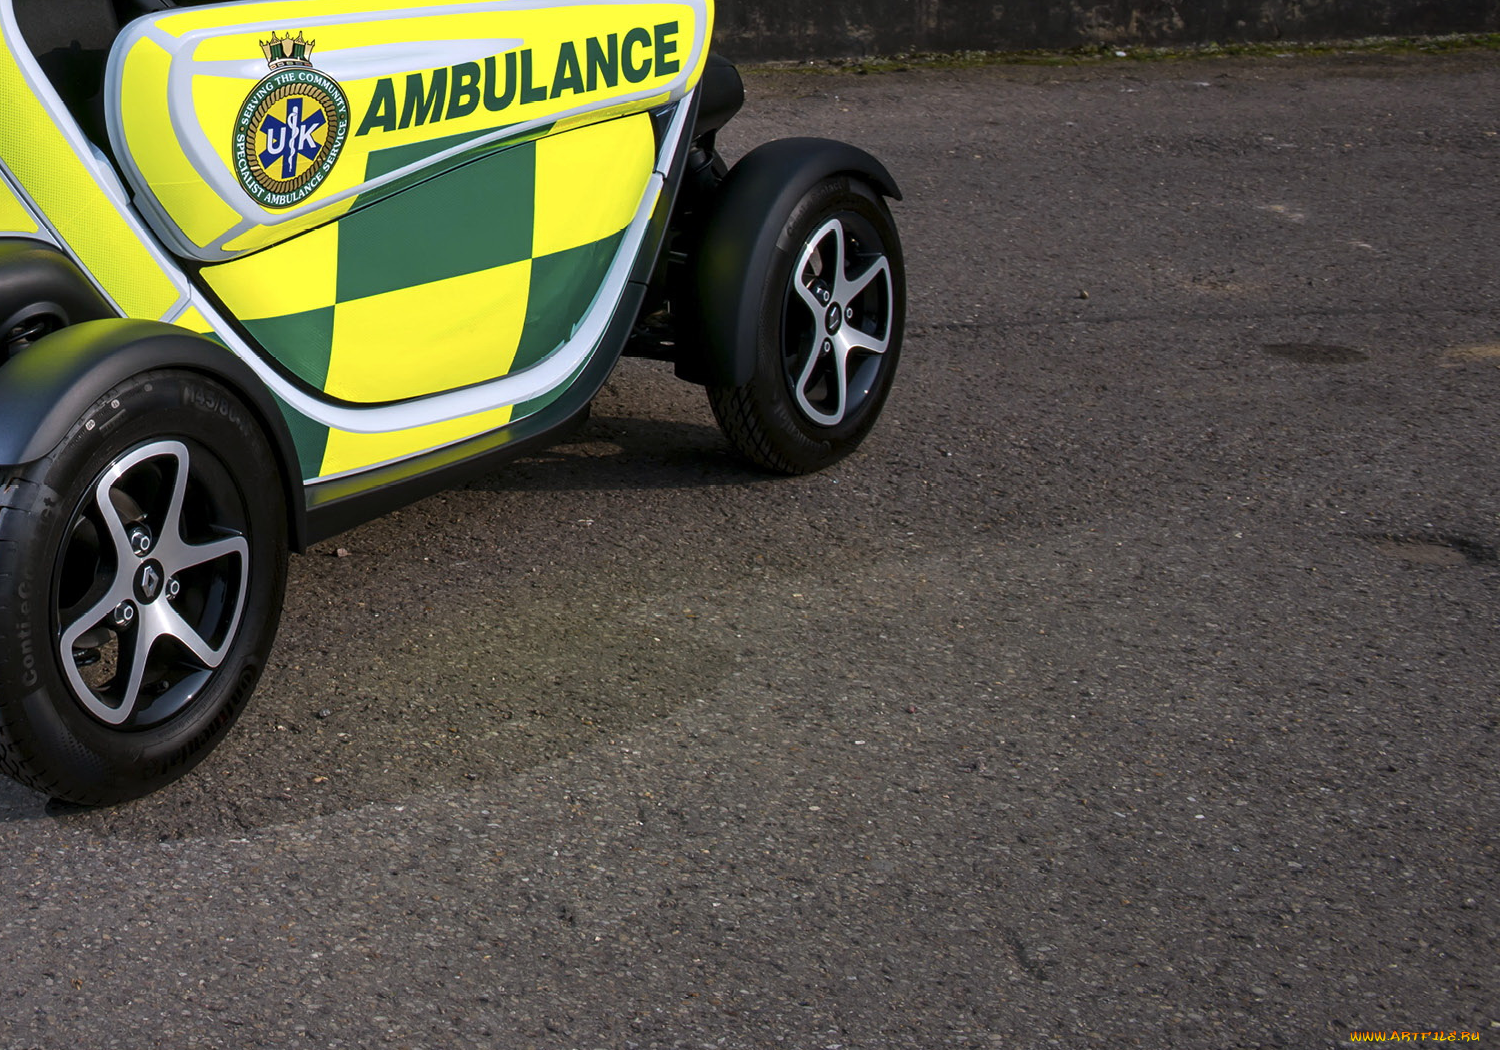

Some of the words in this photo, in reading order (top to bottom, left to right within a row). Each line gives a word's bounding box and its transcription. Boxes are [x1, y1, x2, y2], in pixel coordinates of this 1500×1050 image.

[241, 80, 274, 126] SERVING
[274, 72, 296, 86] THE
[298, 72, 348, 113] COMMUNITY
[354, 20, 680, 137] AMBULANCE
[236, 133, 265, 198] SPECIALIST
[264, 172, 324, 205] AMBULANCE
[322, 119, 348, 172] SERVICE
[267, 122, 320, 155] UK
